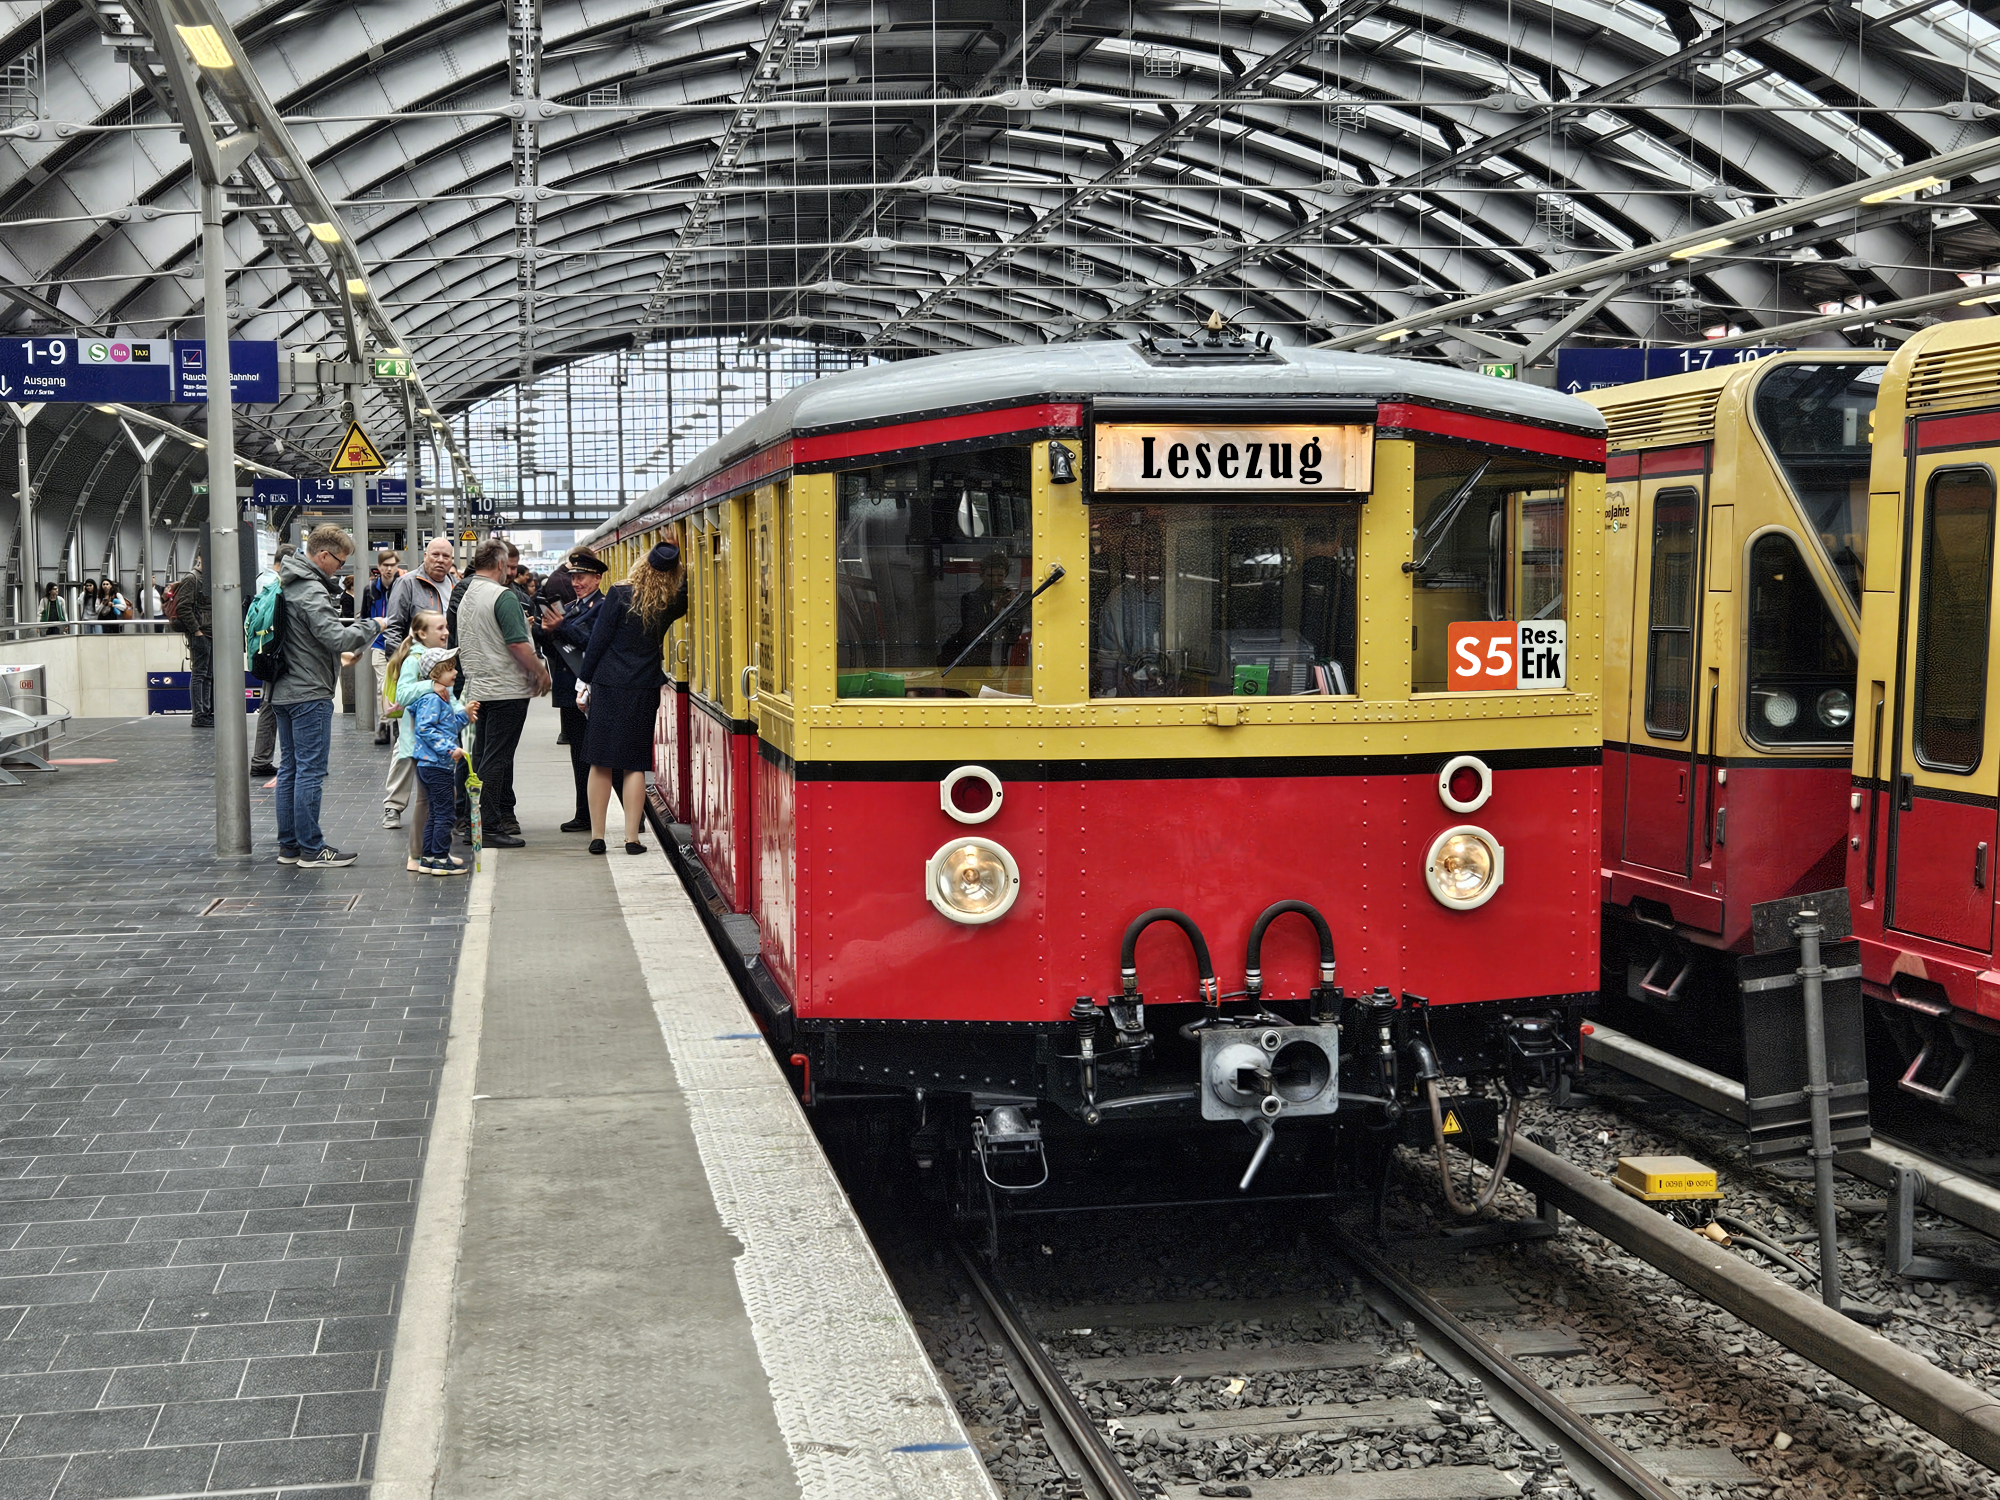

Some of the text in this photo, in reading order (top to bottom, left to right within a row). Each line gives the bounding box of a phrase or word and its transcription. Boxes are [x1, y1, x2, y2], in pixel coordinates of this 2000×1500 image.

[21, 340, 66, 364] 1-9
[91, 344, 105, 361] S
[114, 349, 127, 357] Bus
[134, 349, 149, 357] TAXI
[1679, 350, 1714, 371] 1-7
[23, 375, 66, 387] Ausgang
[1141, 436, 1323, 485] Lesezug
[315, 479, 335, 490] 1-9
[475, 498, 493, 512] 10
[1521, 627, 1564, 645] Res.
[1455, 636, 1513, 677] S5
[1521, 647, 1561, 679] Erk
[20, 680, 33, 689] DB
